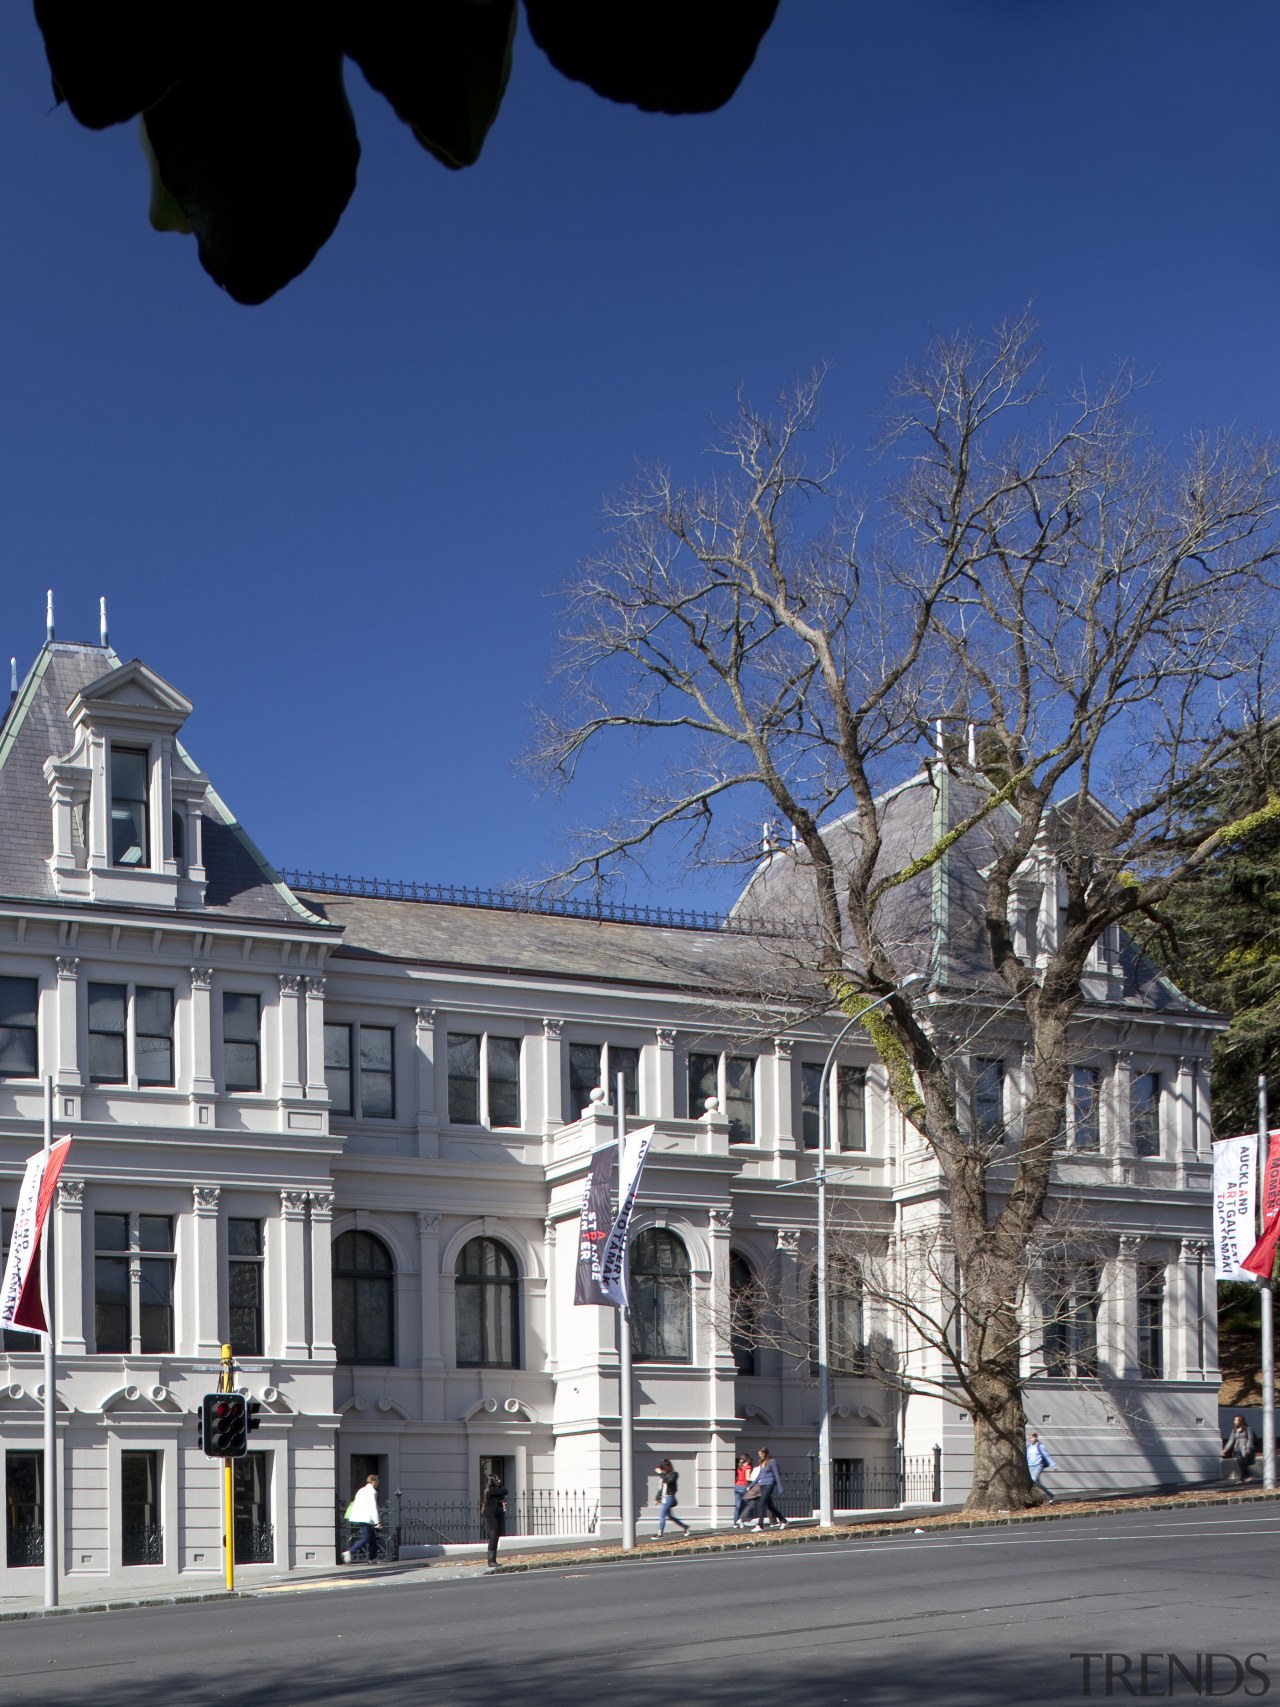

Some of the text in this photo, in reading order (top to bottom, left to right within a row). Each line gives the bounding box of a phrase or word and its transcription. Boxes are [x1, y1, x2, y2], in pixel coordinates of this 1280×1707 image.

[1226, 1182, 1238, 1207] ART
[1238, 1146, 1250, 1215] AUCKLAND
[580, 1172, 594, 1261] ENCOUNTER
[588, 1211, 602, 1281] STRANGE
[597, 1230, 607, 1240] A
